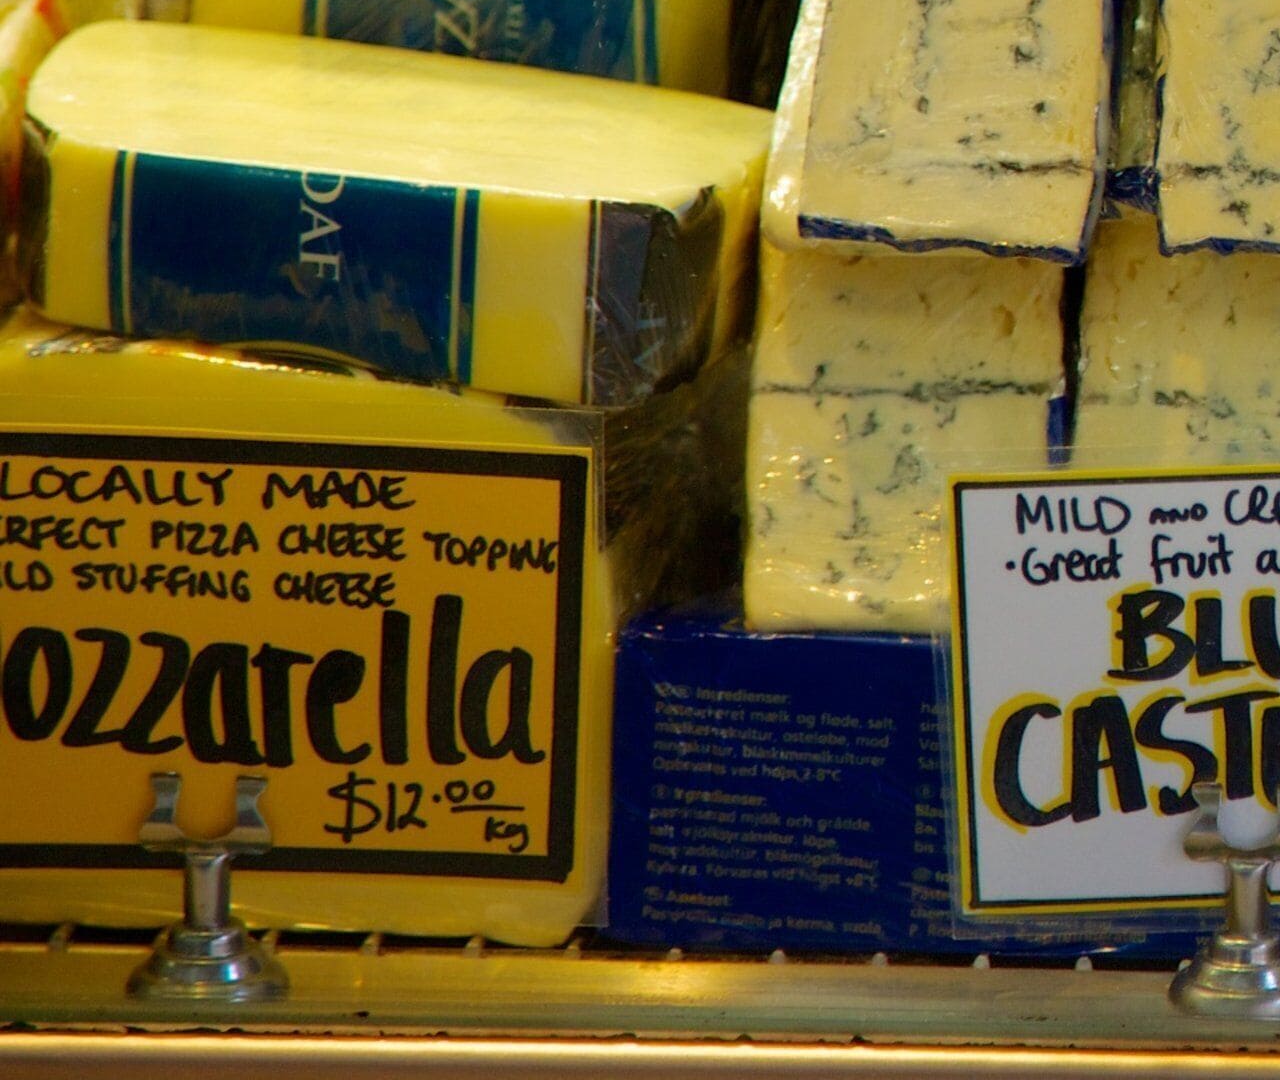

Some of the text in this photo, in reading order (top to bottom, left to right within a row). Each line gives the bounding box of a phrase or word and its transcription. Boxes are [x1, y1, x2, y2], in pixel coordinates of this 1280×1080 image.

[0, 460, 416, 512] LOCALLY MADE
[1015, 492, 1133, 537] MILD
[151, 522, 260, 558] PIZZA
[277, 521, 408, 562] CHEESE
[423, 530, 558, 575] TOPPING
[1020, 538, 1123, 586] Great
[1150, 532, 1235, 586] fruit
[0, 560, 398, 610] LD STUFFING CHEESE
